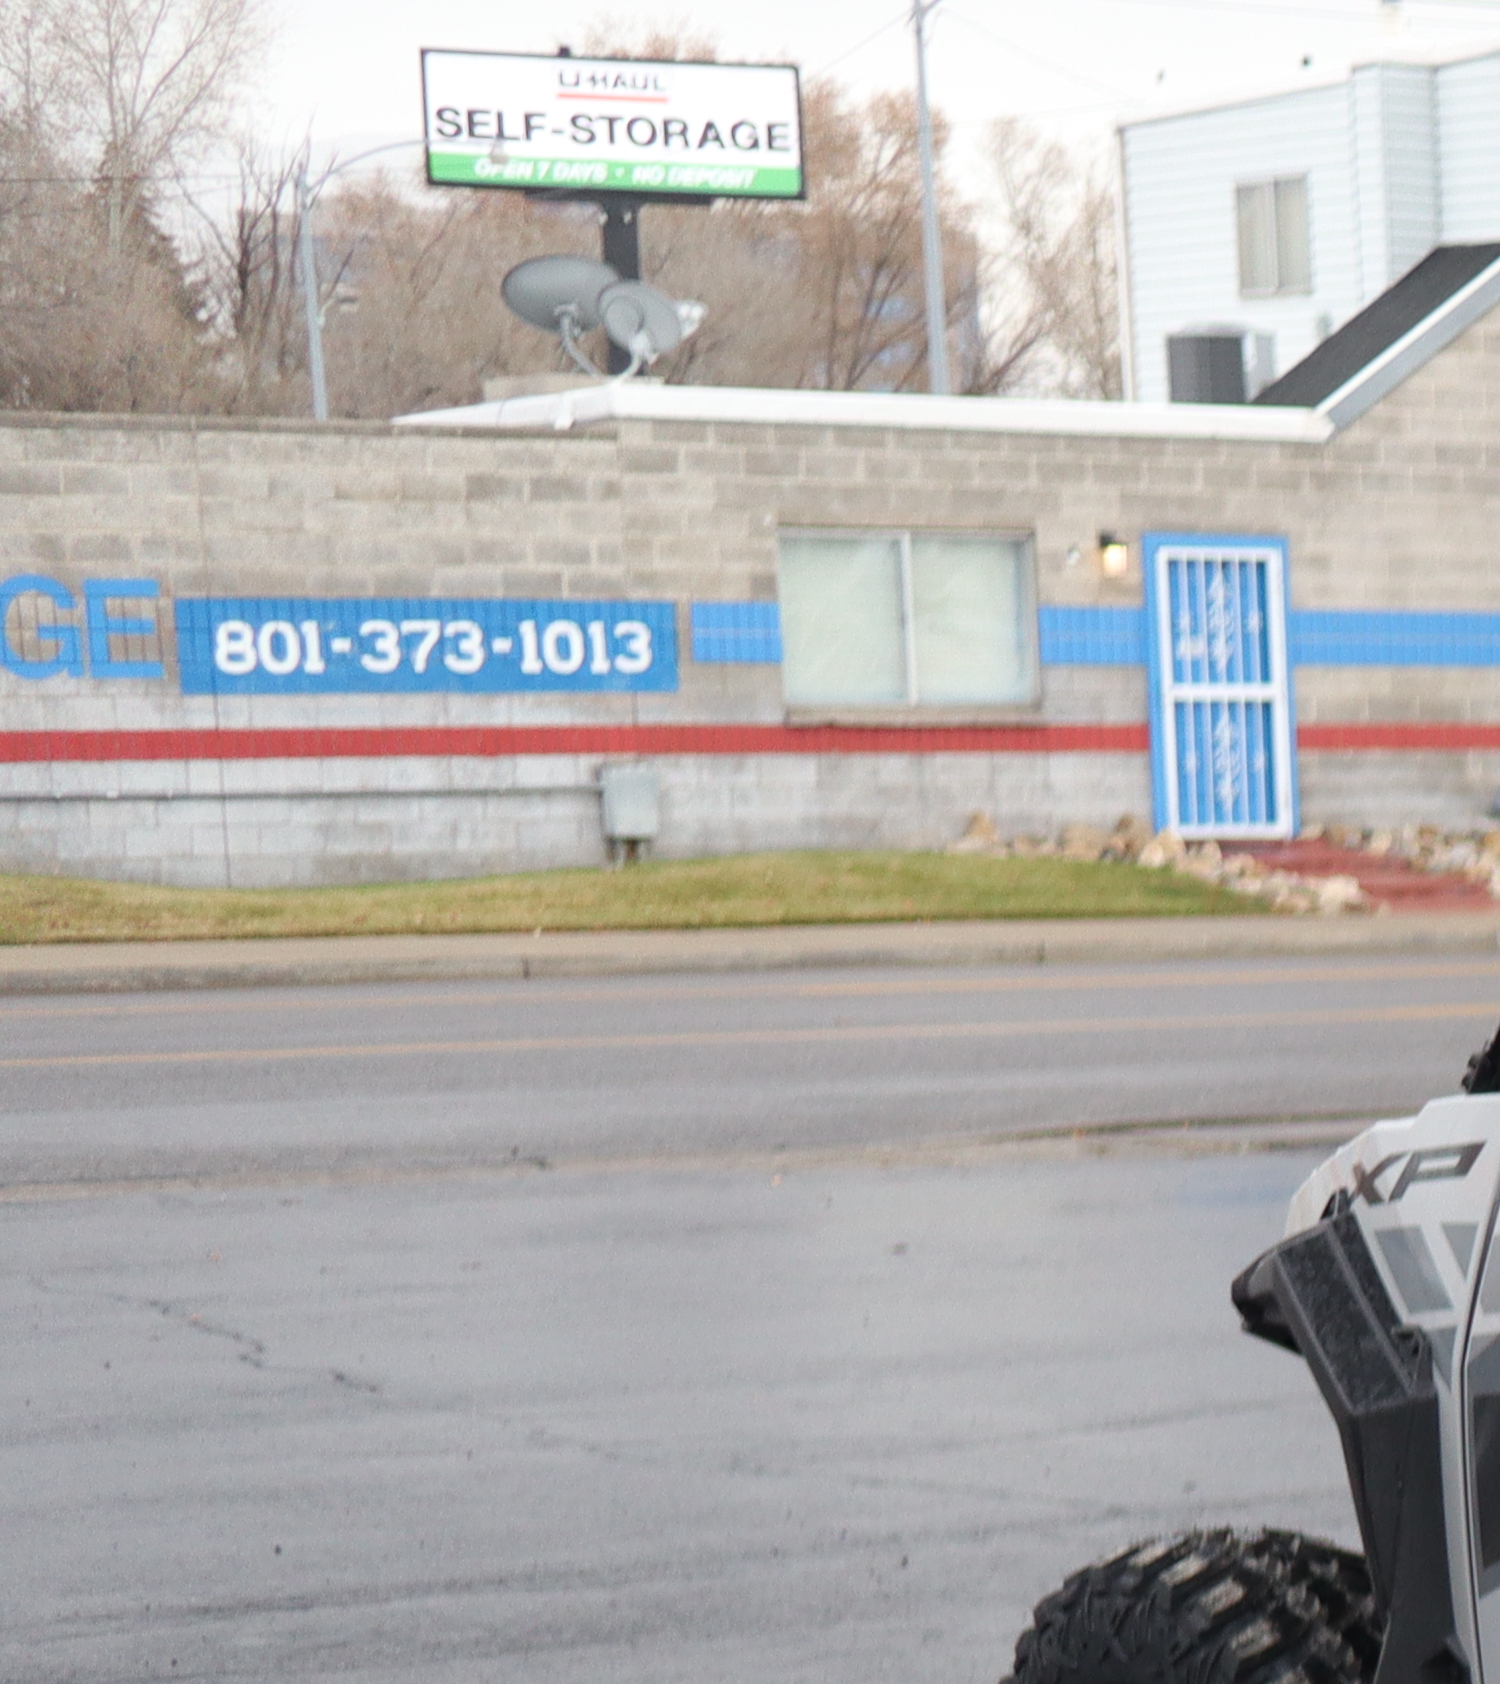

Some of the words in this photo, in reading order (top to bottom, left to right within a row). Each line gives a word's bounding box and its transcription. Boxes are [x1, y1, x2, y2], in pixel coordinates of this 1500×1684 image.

[435, 106, 791, 151] SELF-STORAGE
[553, 161, 608, 183] DAYS
[632, 164, 666, 186] NO
[668, 166, 757, 189] DEPOSIT
[213, 619, 654, 676] 801-373-1013
[1350, 1139, 1487, 1206] XP
